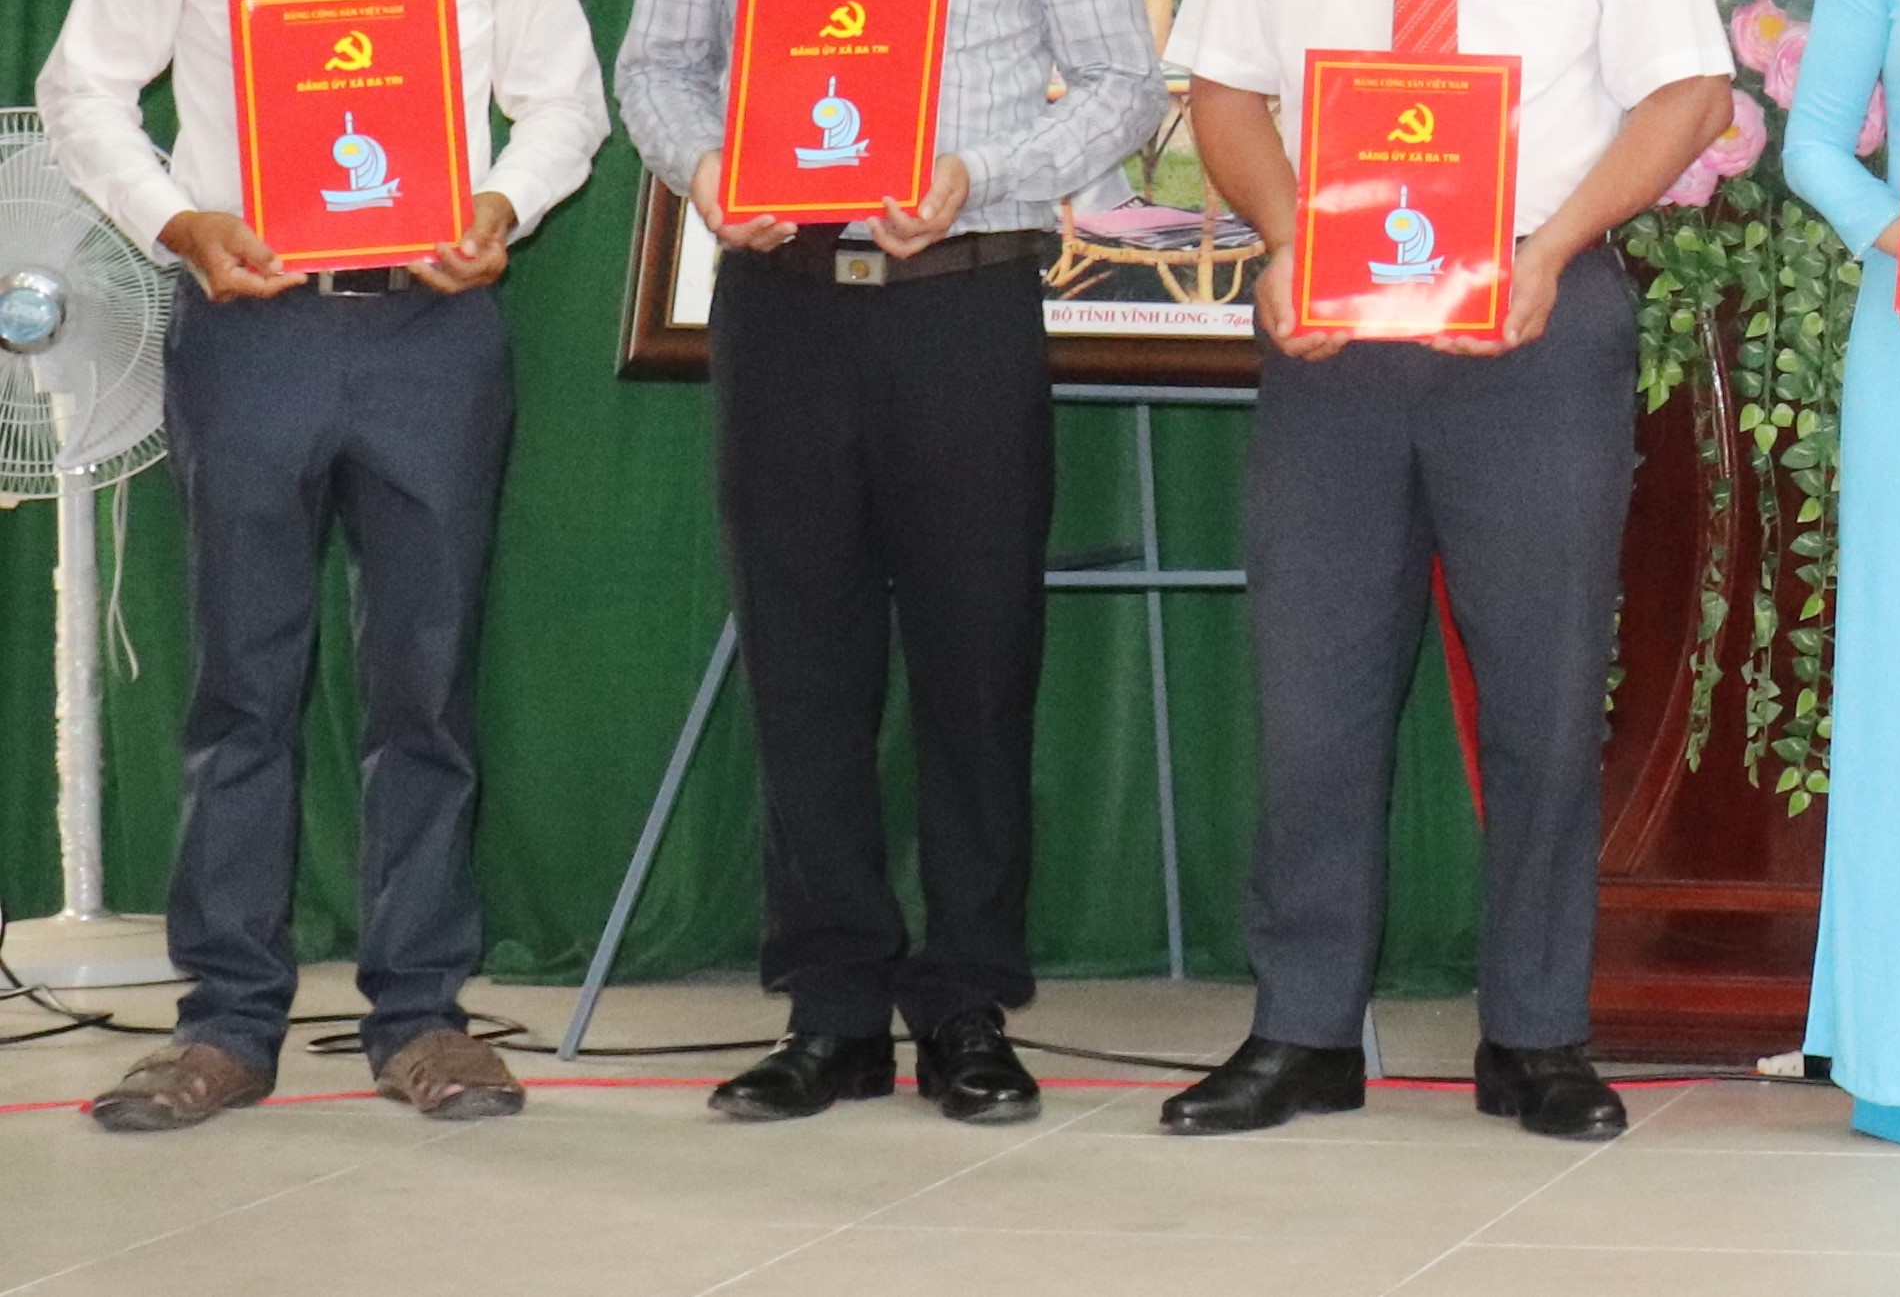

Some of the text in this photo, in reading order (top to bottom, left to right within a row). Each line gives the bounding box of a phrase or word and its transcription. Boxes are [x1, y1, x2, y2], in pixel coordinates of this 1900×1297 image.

[1051, 306, 1072, 322] BỘ
[1121, 308, 1160, 324] VĨNH
[1164, 312, 1208, 324] LONG
